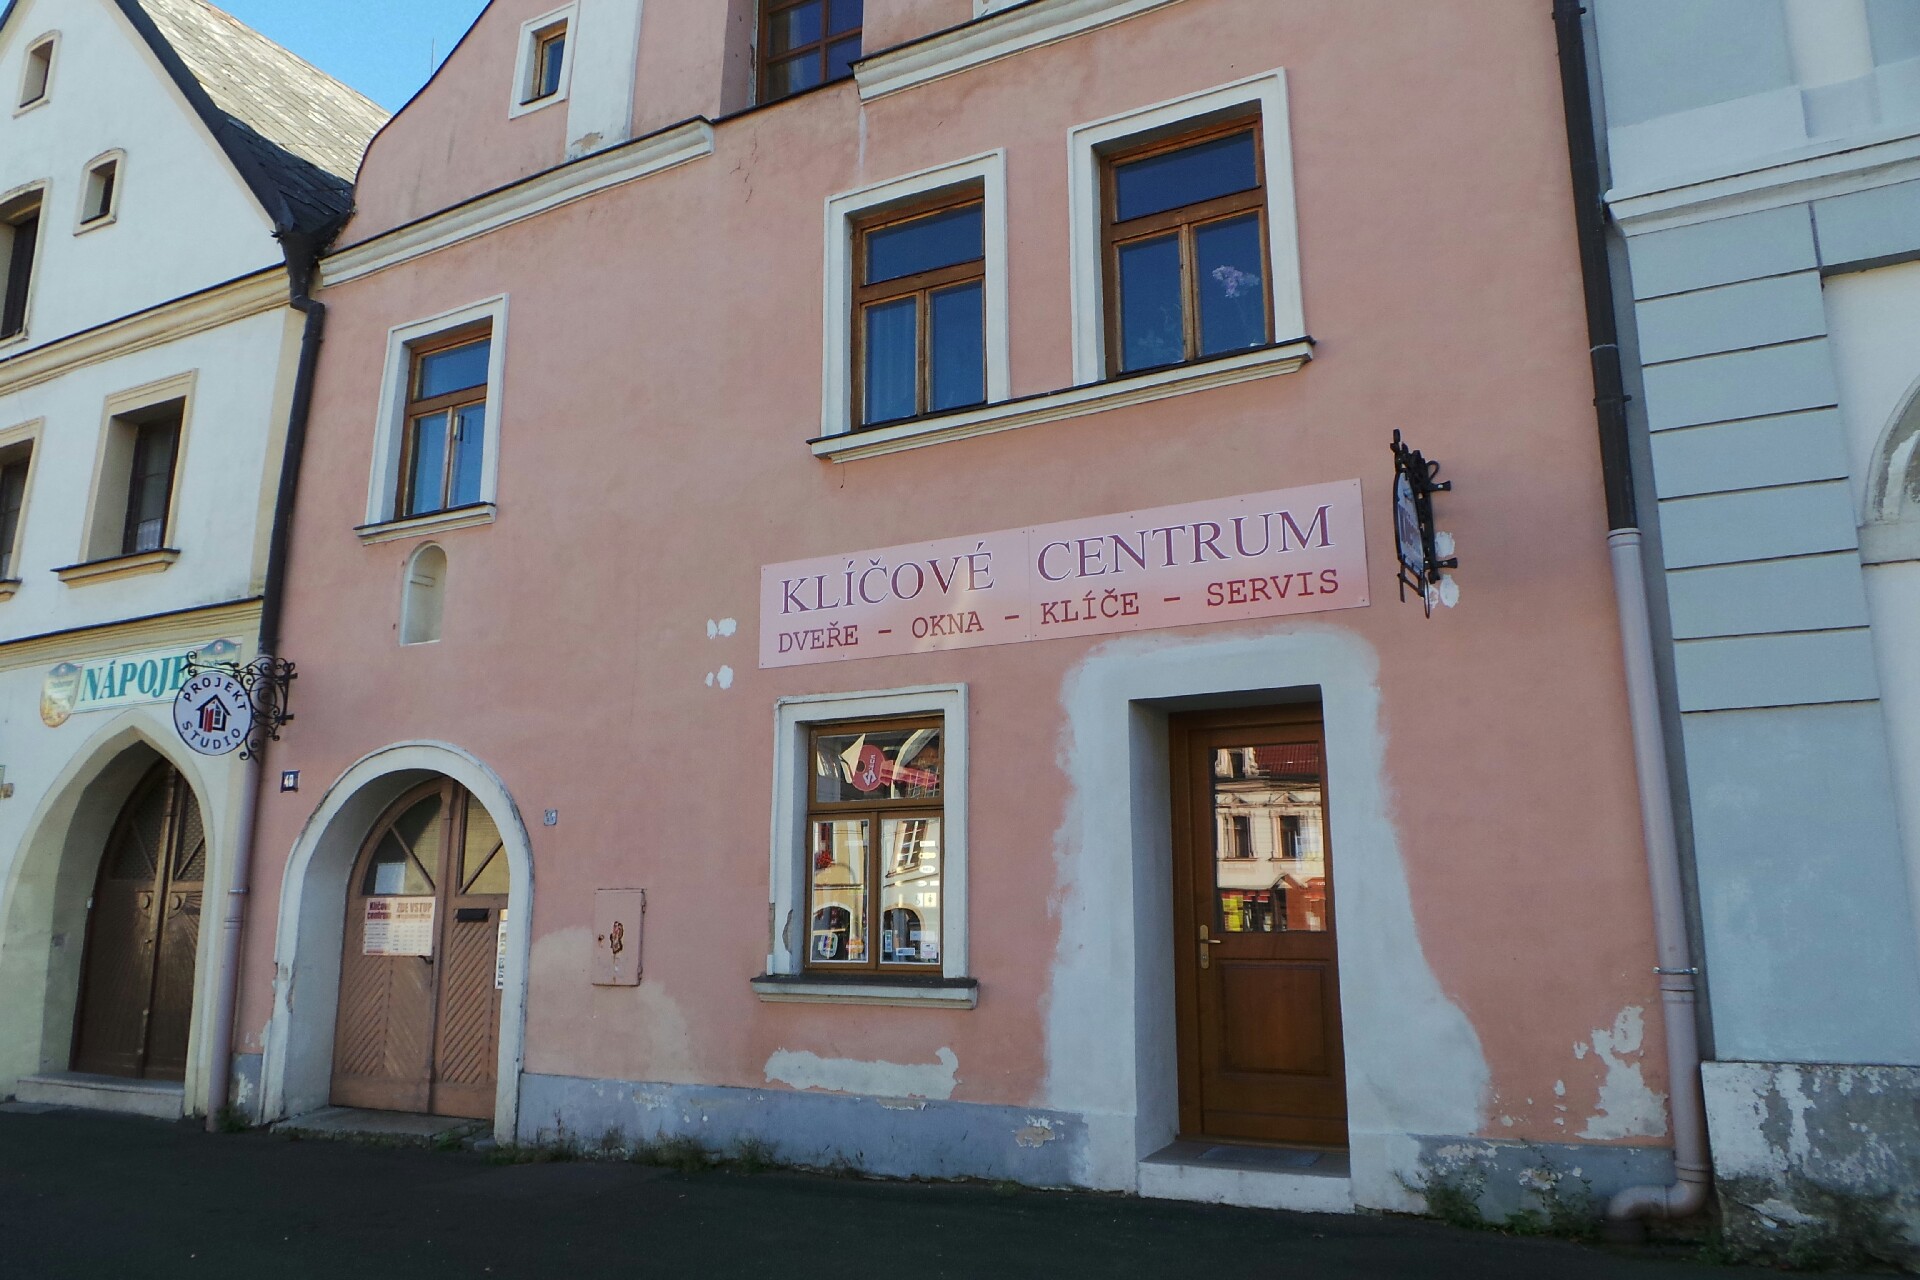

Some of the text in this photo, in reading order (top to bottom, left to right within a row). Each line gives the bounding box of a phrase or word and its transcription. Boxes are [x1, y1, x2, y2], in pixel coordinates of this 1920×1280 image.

[779, 541, 996, 616] KLÍČOVÉ
[1036, 503, 1336, 583] CENTRUM
[778, 621, 859, 653] DVEŘE
[911, 611, 985, 639] OKNA
[1040, 588, 1140, 626] KLÍČE
[1207, 569, 1340, 607] SERVIS
[183, 677, 247, 711] PROJEKT
[182, 721, 241, 750] STUDIO
